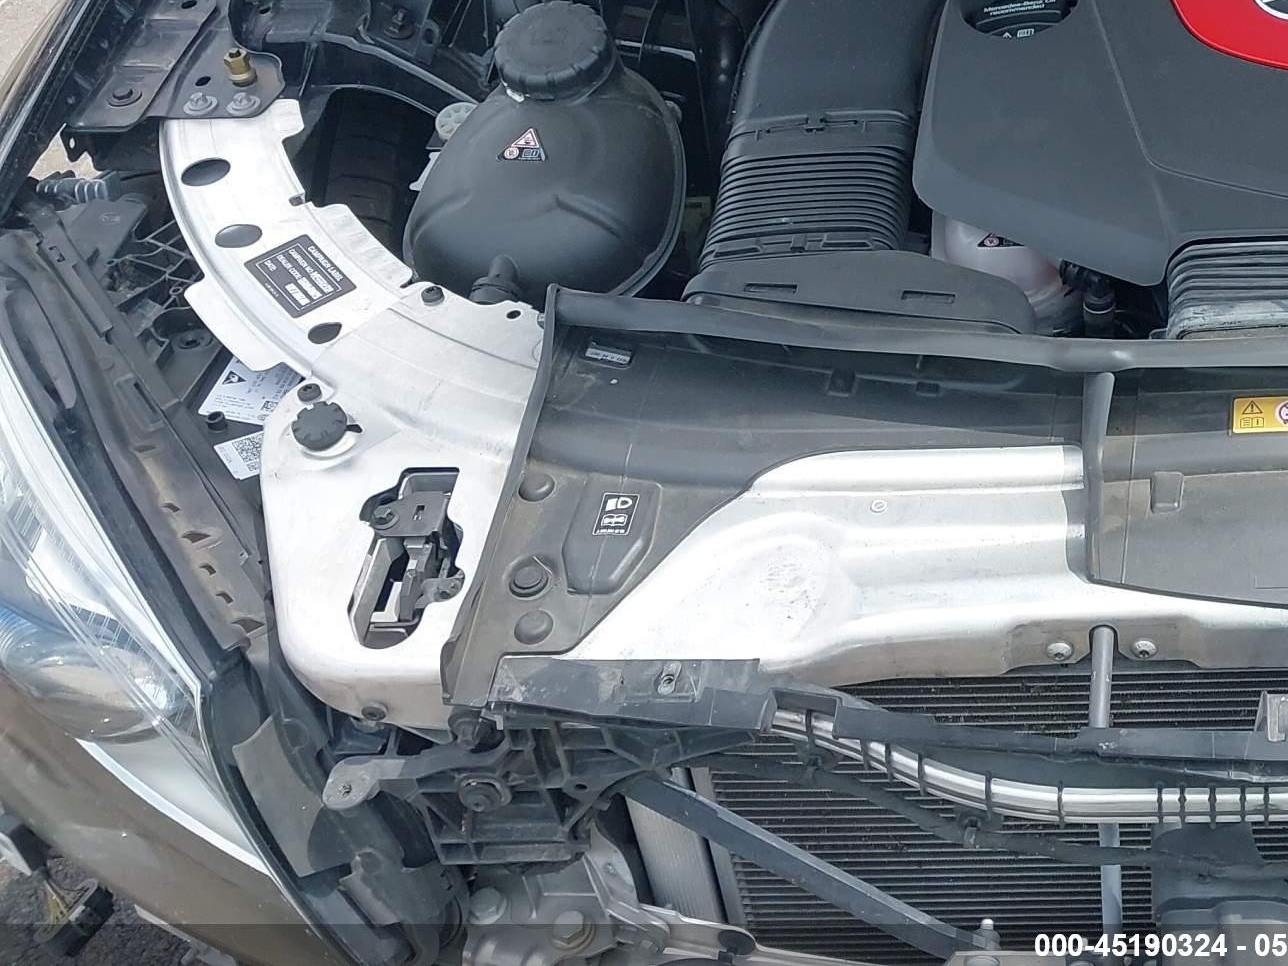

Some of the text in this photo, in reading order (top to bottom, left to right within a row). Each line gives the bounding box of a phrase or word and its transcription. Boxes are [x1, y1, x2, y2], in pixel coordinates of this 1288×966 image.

[983, 0, 1043, 13] Mercedes-Benz
[989, 4, 1045, 16] recommended
[307, 245, 331, 269] CAMPAIGN
[327, 266, 344, 282] LABEL
